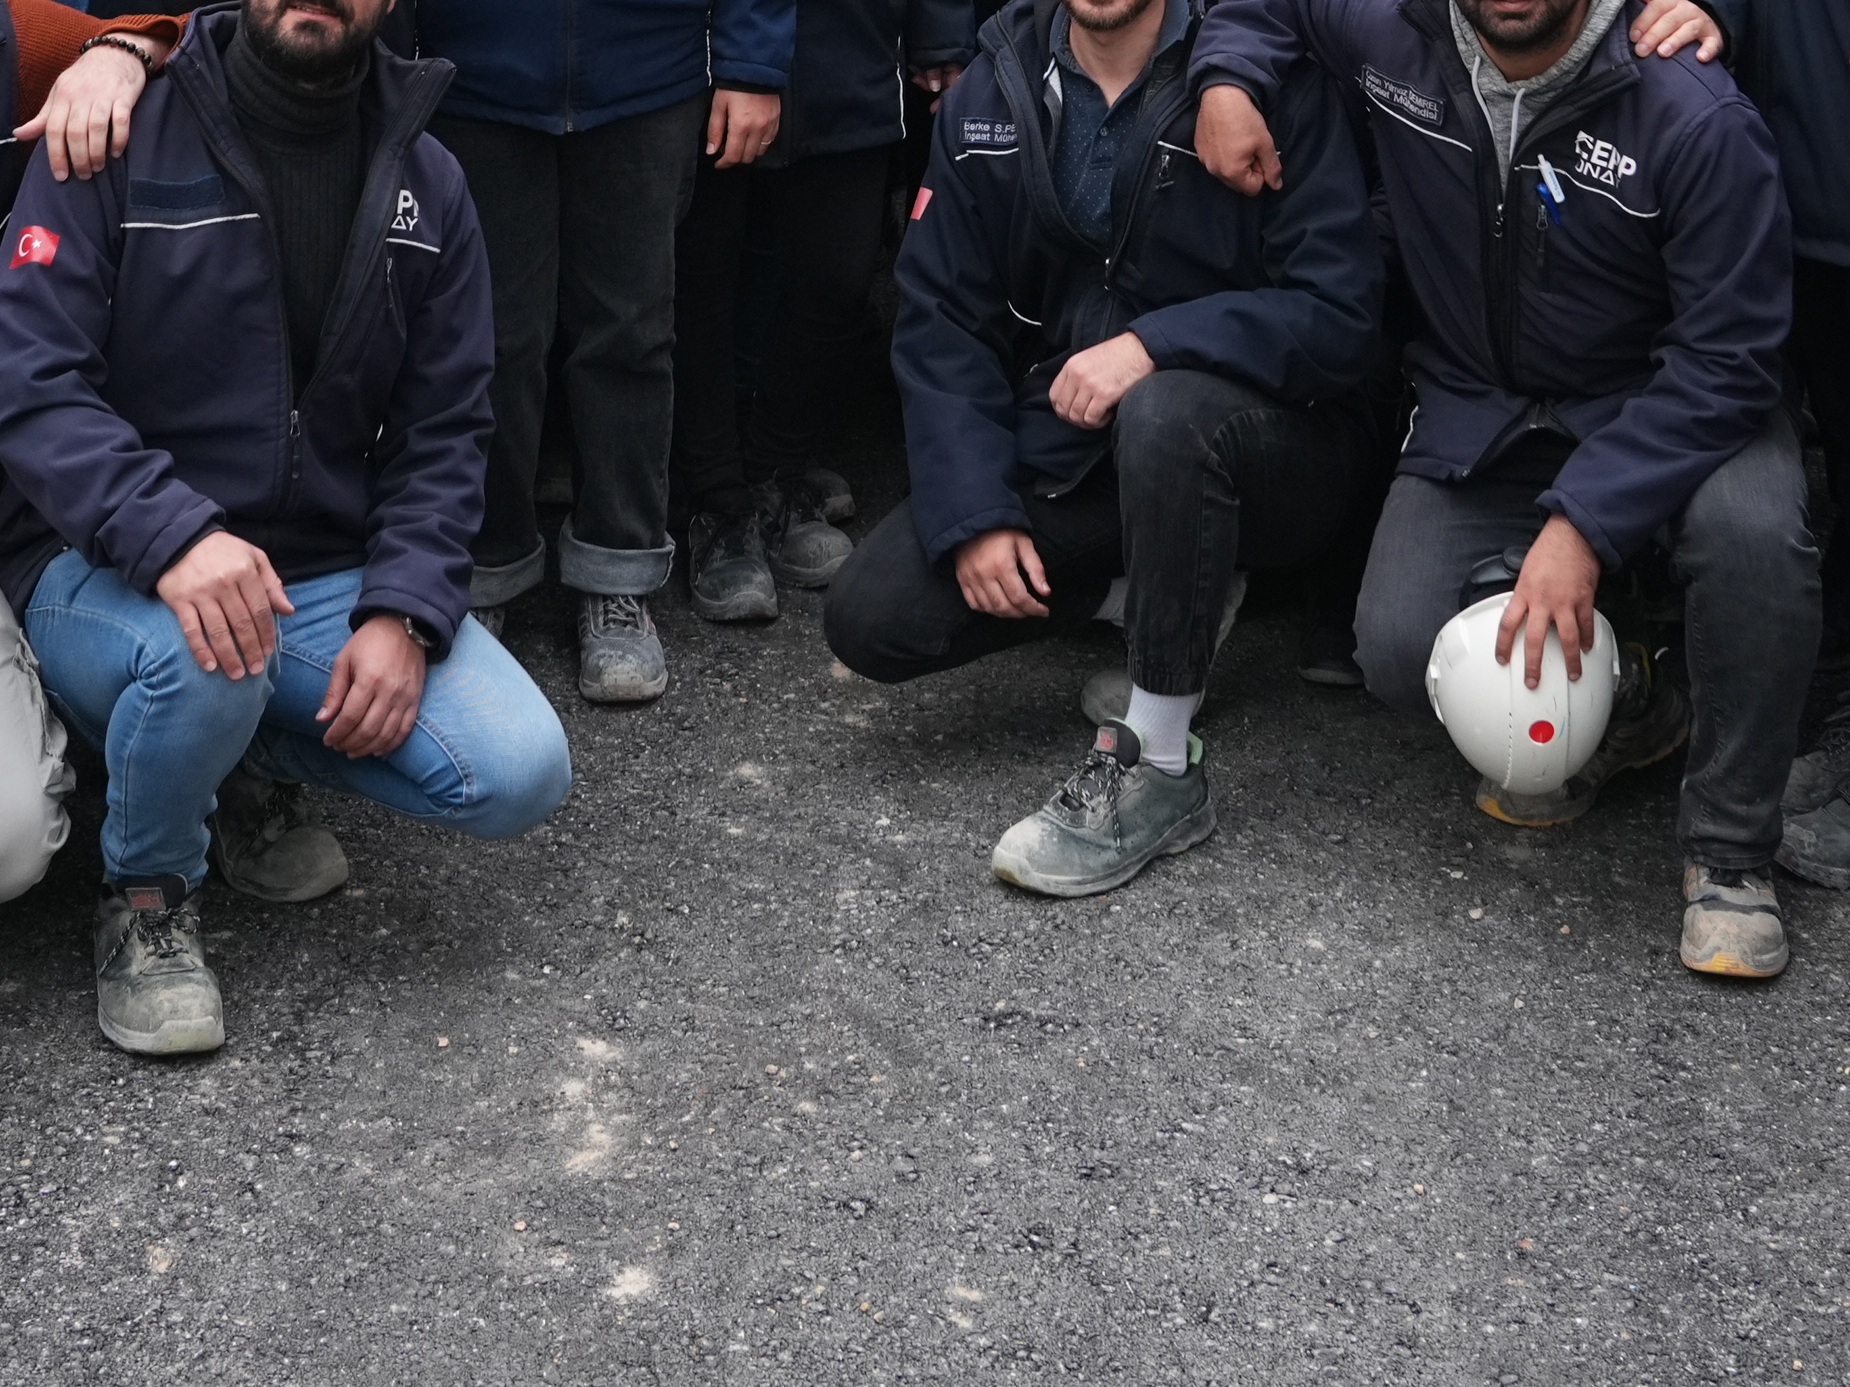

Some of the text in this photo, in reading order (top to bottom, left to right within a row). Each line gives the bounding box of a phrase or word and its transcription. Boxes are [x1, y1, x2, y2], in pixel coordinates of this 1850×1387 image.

[964, 121, 990, 131] Berke
[1589, 138, 1637, 176] EPP
[391, 215, 419, 231] AY
